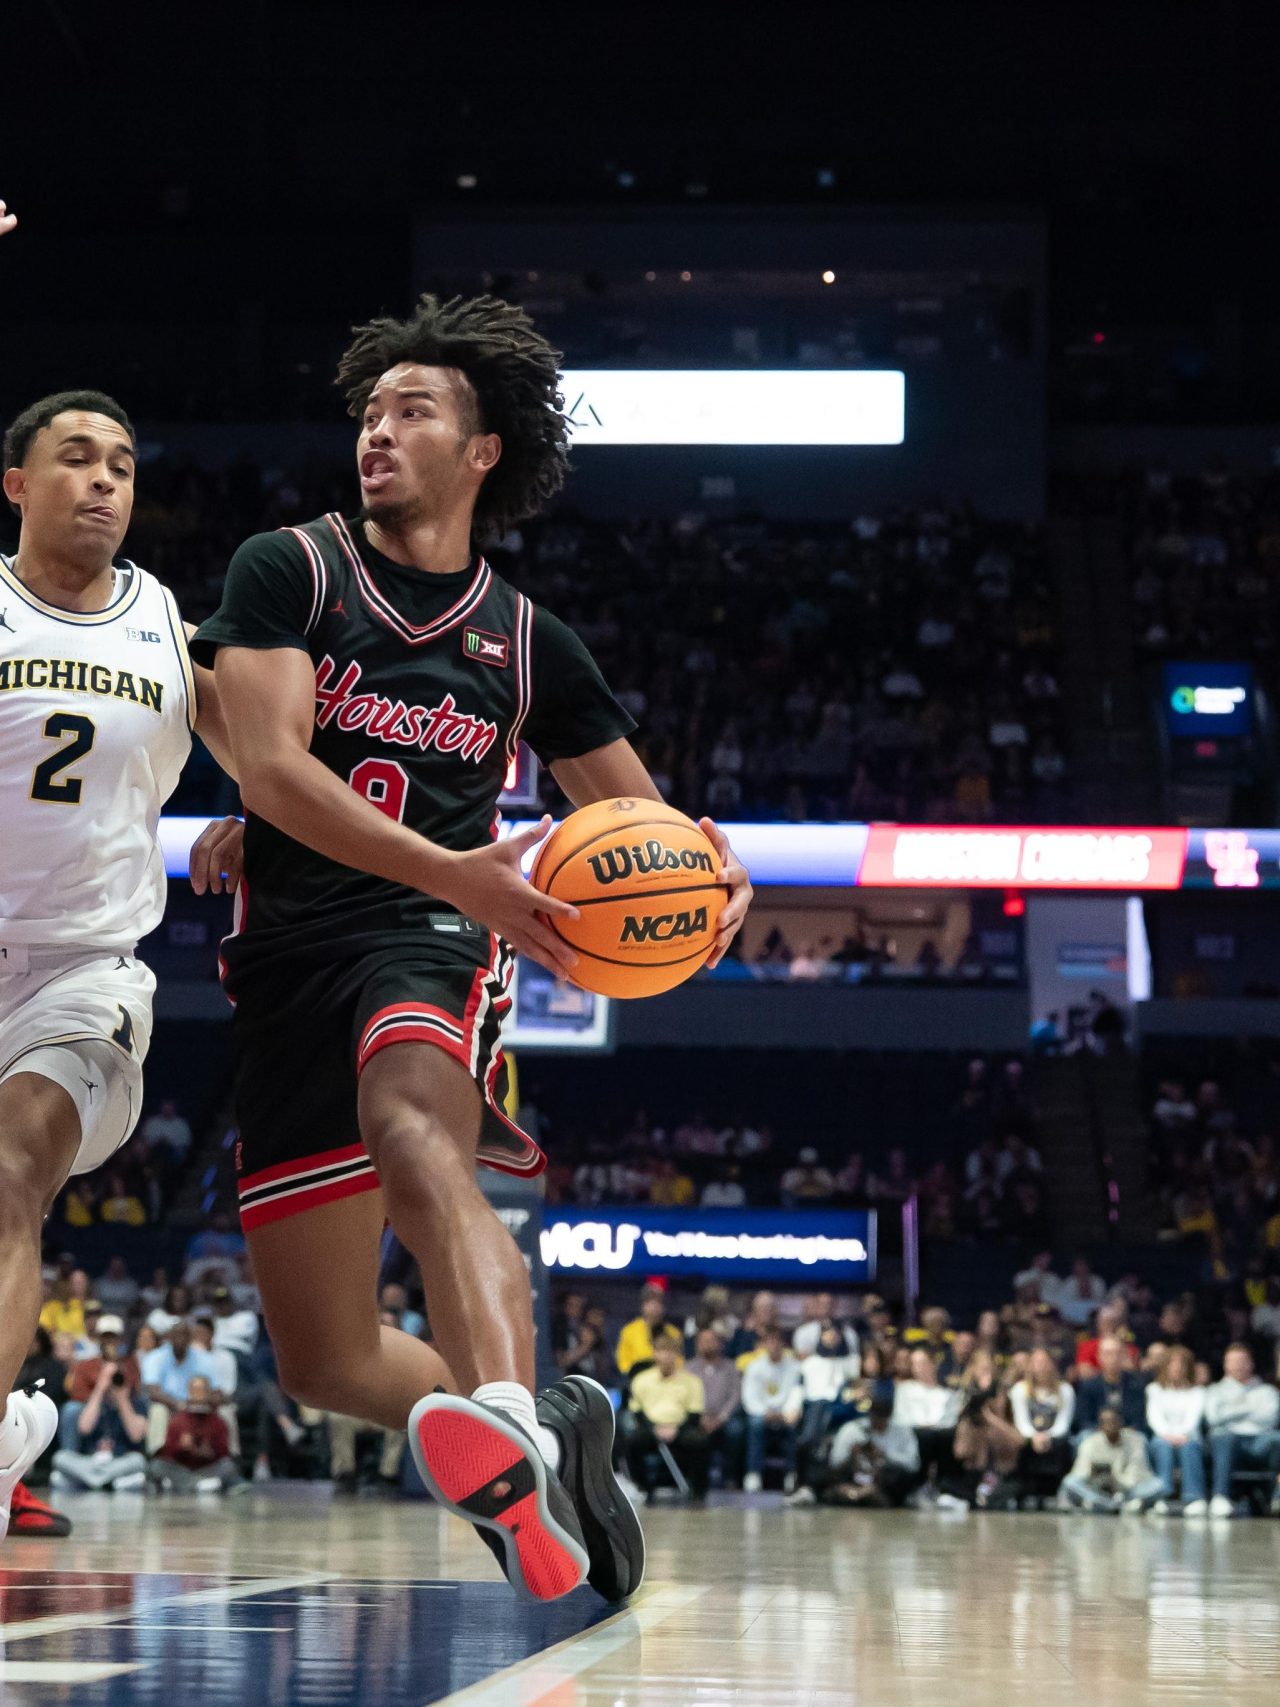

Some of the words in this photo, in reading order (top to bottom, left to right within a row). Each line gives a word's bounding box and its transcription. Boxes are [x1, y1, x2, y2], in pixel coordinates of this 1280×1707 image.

[315, 653, 498, 764] Houston
[29, 709, 96, 806] 2
[587, 839, 715, 885] Wilson
[465, 921, 473, 931] L
[619, 906, 709, 944] NCAA
